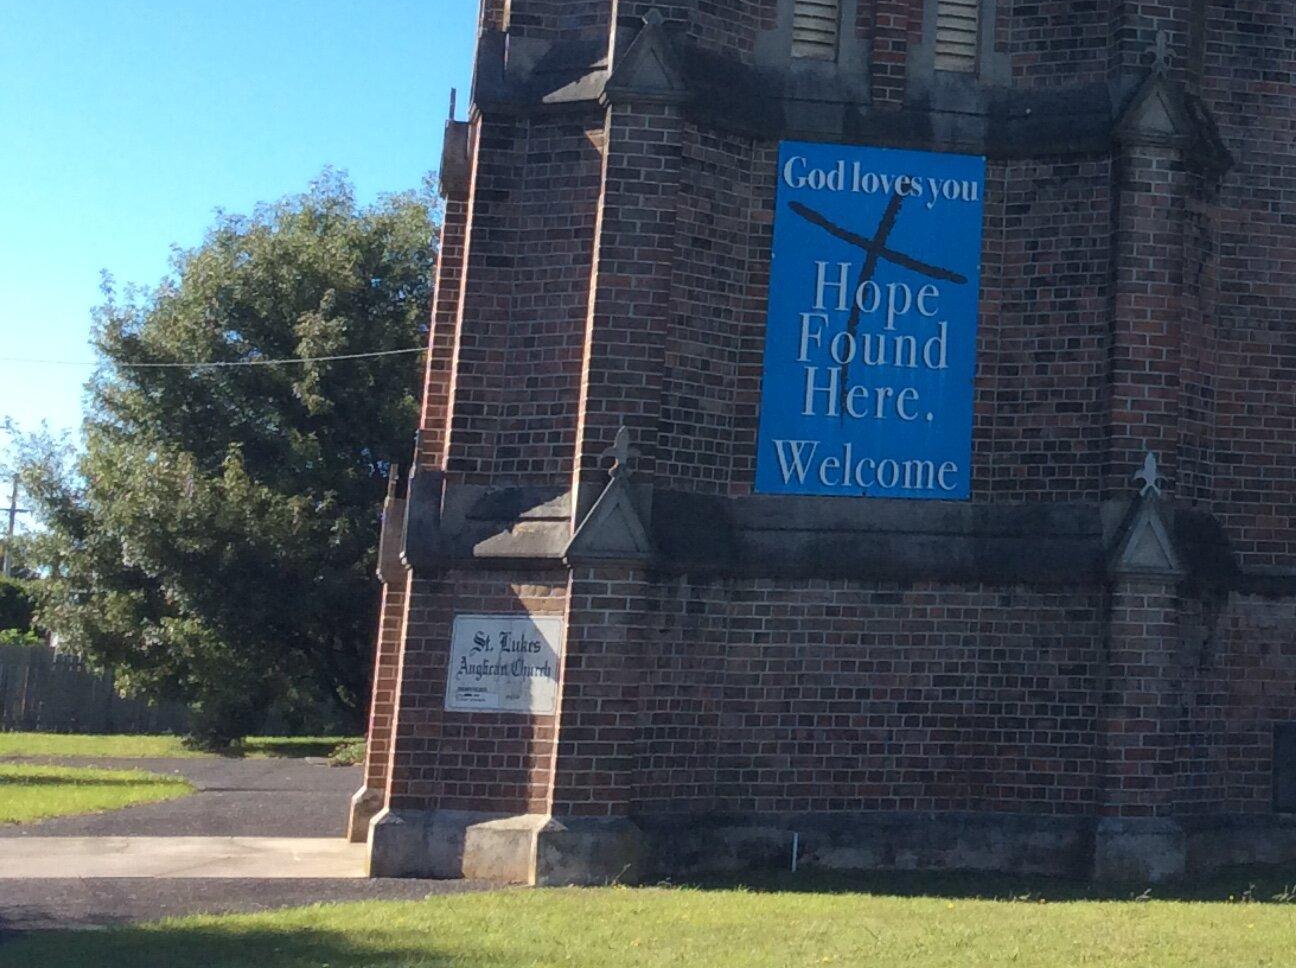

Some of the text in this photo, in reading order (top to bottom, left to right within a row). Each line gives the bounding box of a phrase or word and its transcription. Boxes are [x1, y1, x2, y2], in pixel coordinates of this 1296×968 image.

[783, 155, 979, 209] God loves you
[812, 261, 940, 330] Hope
[796, 312, 948, 369] Found
[802, 366, 934, 421] Here.
[772, 439, 958, 491] Welcome
[456, 656, 552, 682] Anglican Church
